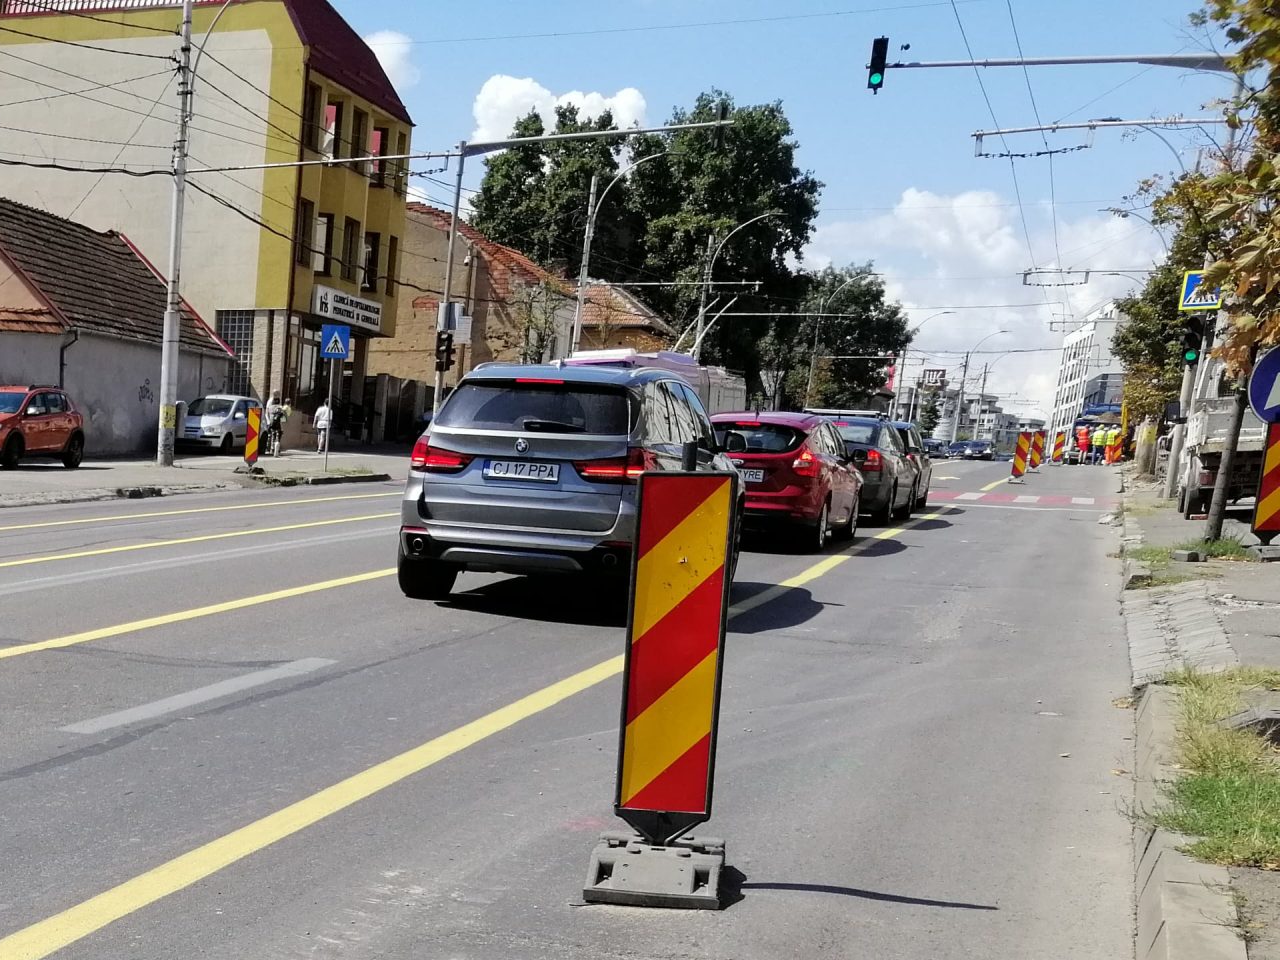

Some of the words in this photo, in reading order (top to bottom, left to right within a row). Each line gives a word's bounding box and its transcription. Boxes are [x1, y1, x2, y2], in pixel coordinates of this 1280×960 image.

[493, 462, 510, 475] CJ
[513, 463, 526, 476] 17
[528, 464, 554, 478] PPA
